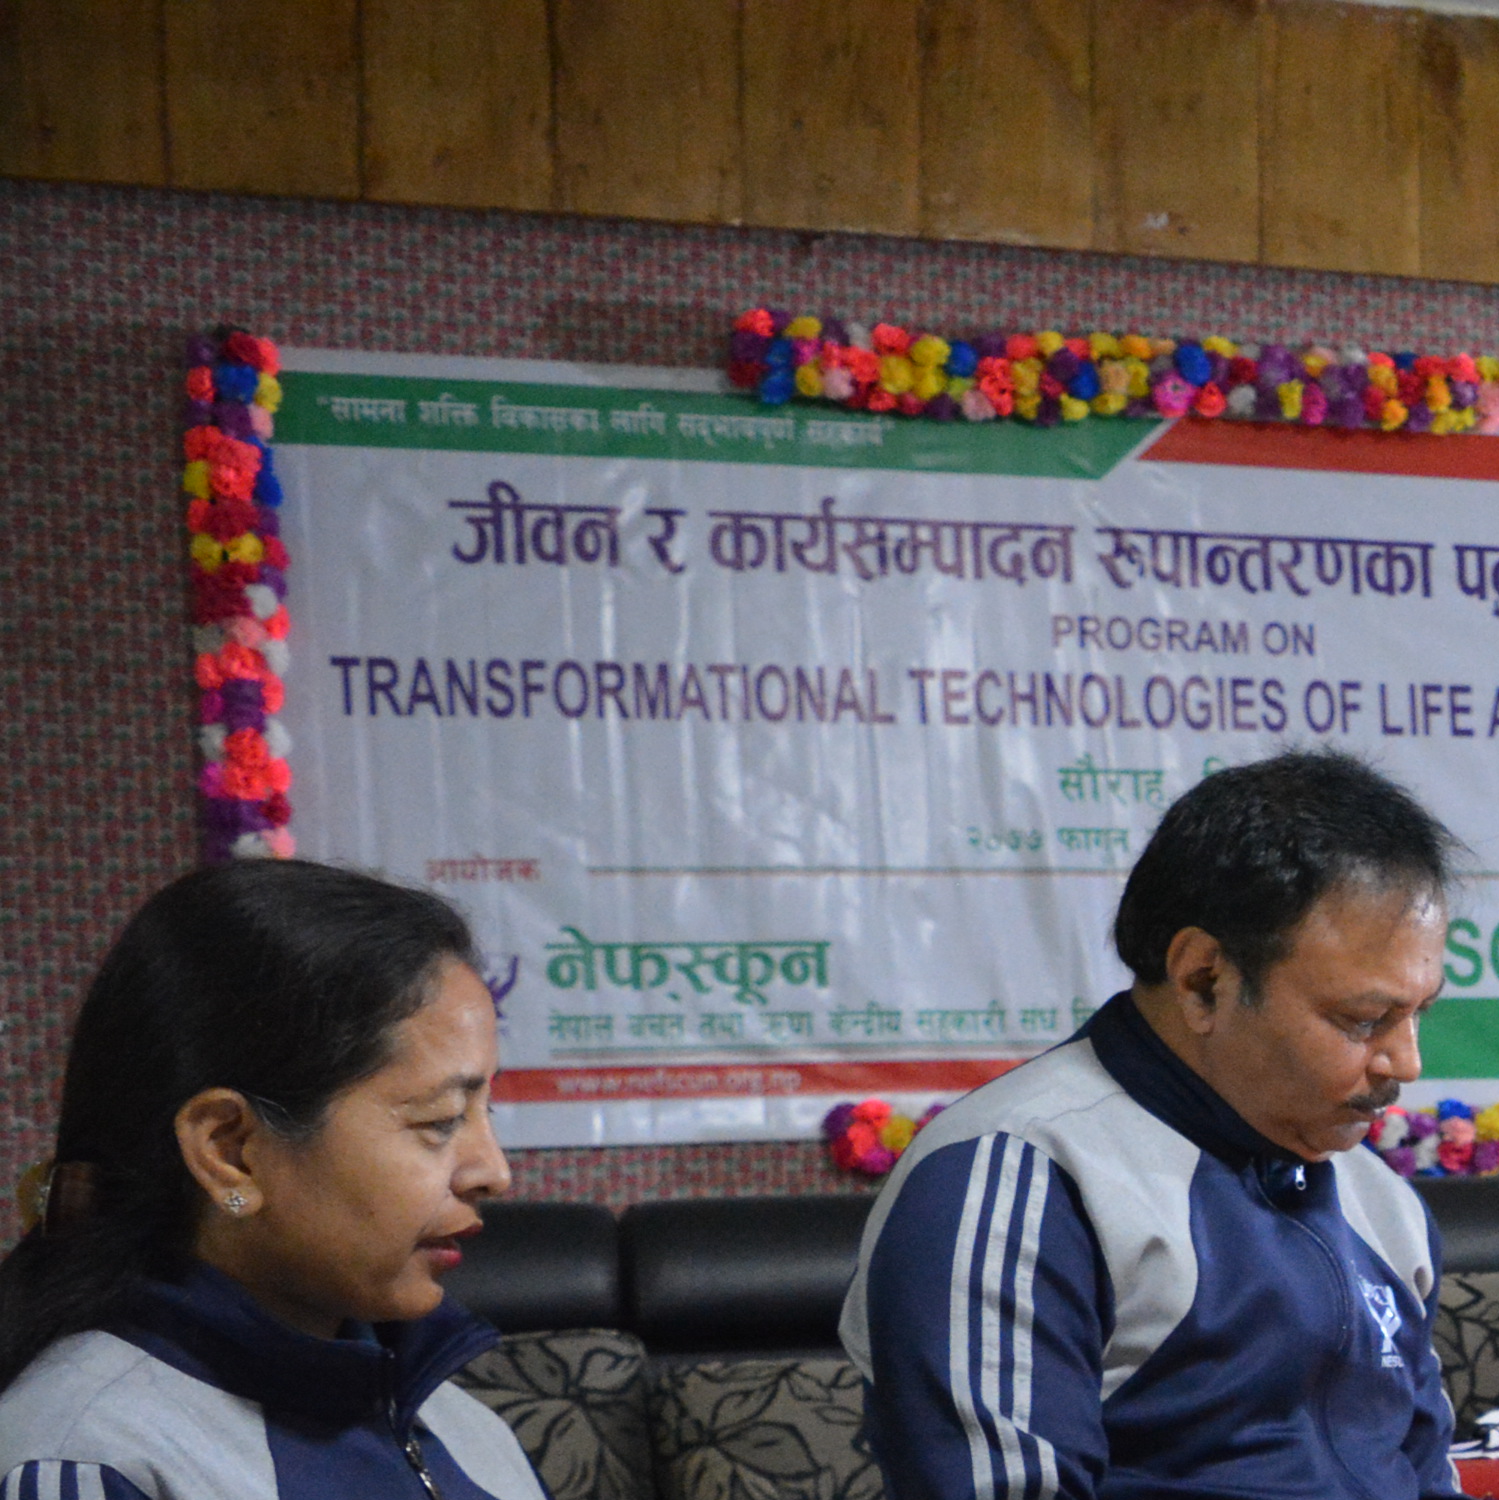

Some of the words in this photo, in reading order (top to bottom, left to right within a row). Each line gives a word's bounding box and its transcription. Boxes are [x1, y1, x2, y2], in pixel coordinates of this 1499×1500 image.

[449, 481, 620, 567] जीवन
[644, 508, 688, 575] र
[707, 497, 1074, 585] कार्यसम्पादन
[1051, 615, 1249, 654] PROGRAM
[1262, 621, 1316, 657] ON
[329, 656, 897, 725] TRANSFORMATIONAL
[908, 669, 1288, 733] TECHNOLOGIES
[1304, 679, 1363, 735] OF
[1379, 682, 1475, 739] LIFE
